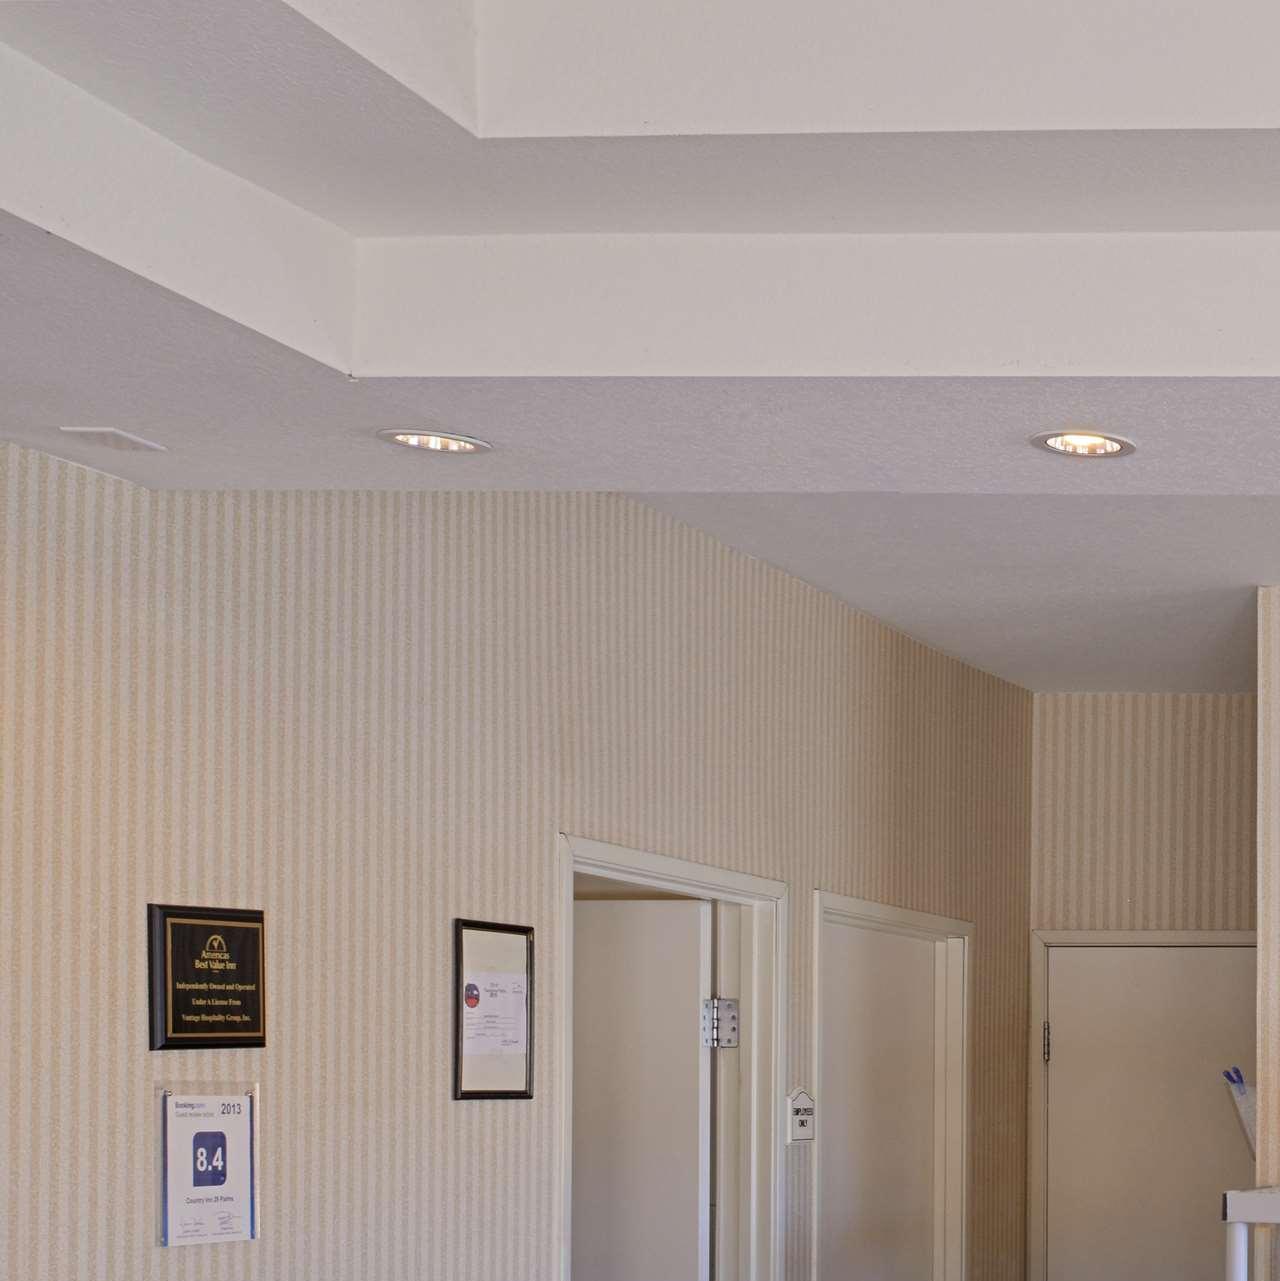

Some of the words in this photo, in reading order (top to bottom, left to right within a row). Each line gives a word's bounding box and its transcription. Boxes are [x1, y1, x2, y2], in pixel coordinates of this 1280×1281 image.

[194, 959, 209, 969] Best
[221, 1103, 242, 1115] 2013
[196, 1147, 224, 1172] 8.4
